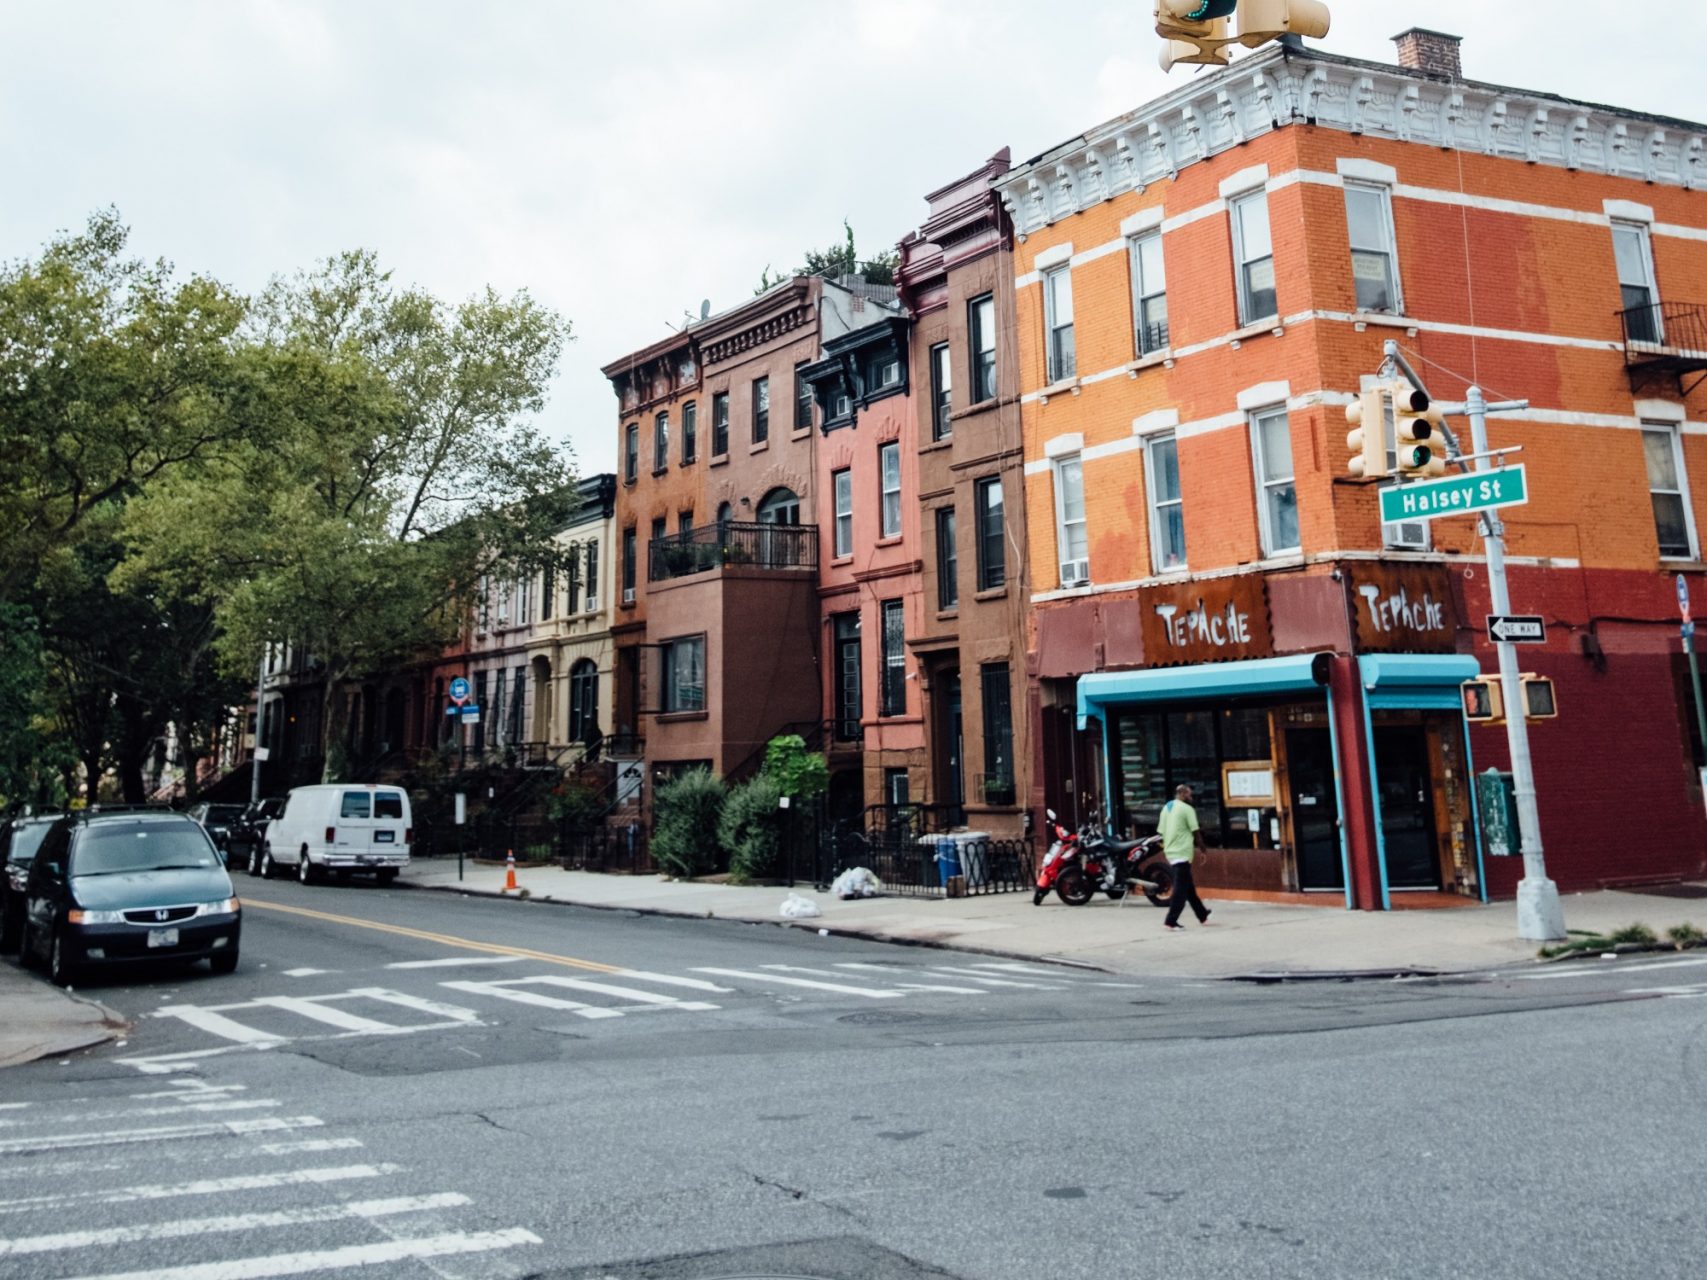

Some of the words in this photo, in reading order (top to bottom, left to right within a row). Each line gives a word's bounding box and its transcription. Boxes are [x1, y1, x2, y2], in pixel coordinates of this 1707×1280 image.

[1403, 487, 1473, 513] Halsey
[1480, 480, 1501, 501] St
[1499, 623, 1516, 635] ONE
[1520, 624, 1536, 634] WAY
